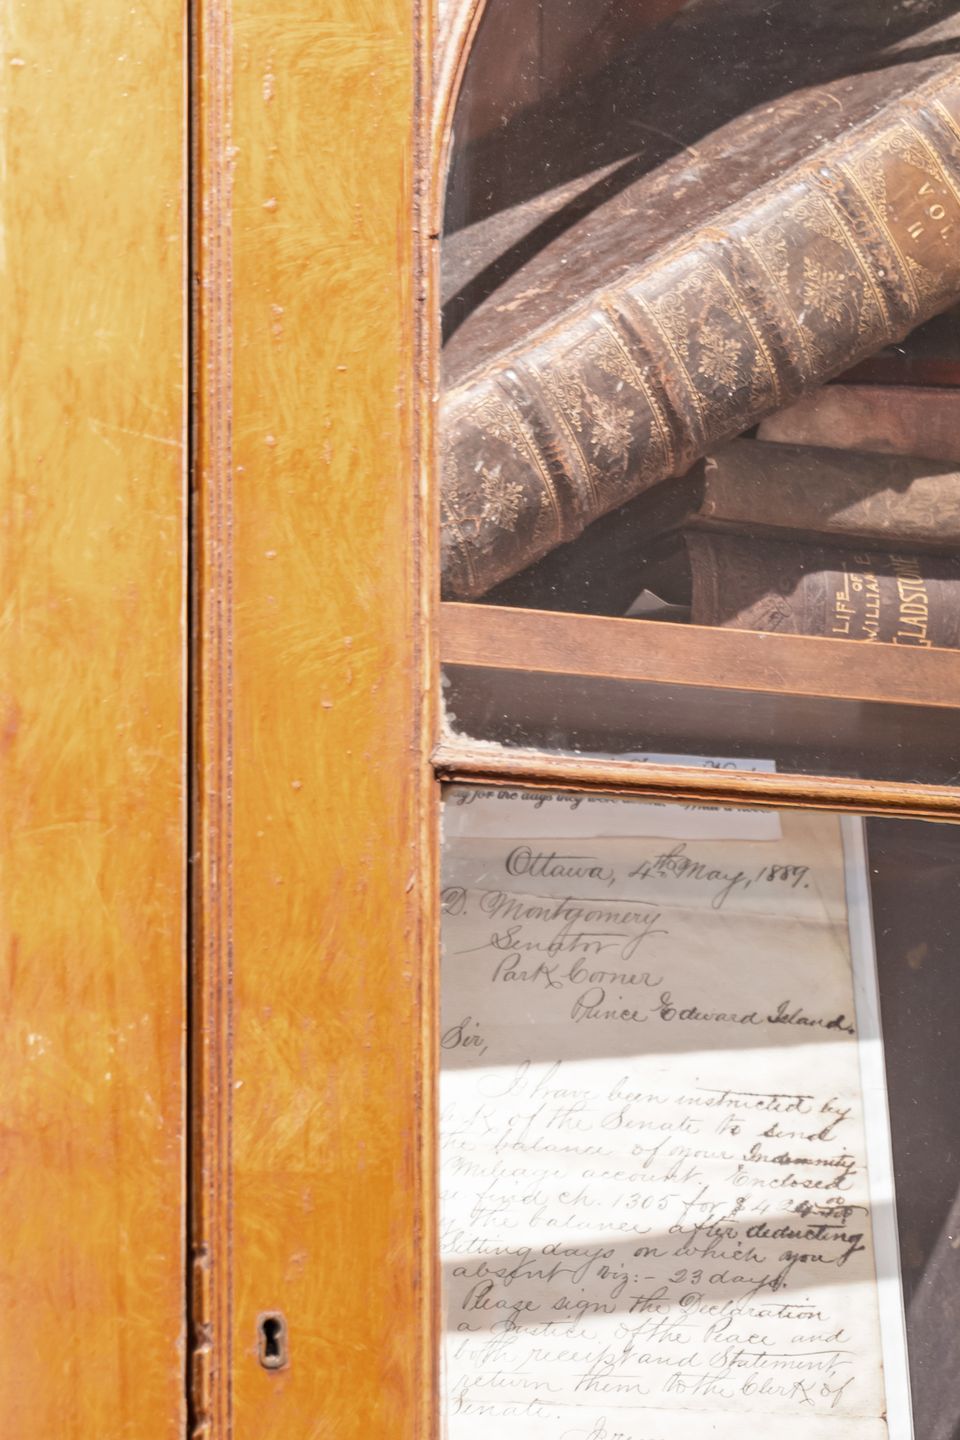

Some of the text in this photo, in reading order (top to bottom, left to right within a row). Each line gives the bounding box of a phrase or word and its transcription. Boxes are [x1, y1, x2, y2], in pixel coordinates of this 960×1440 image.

[479, 889, 668, 948] Montgomery
[491, 952, 564, 990] Park
[650, 990, 764, 1026] Edward
